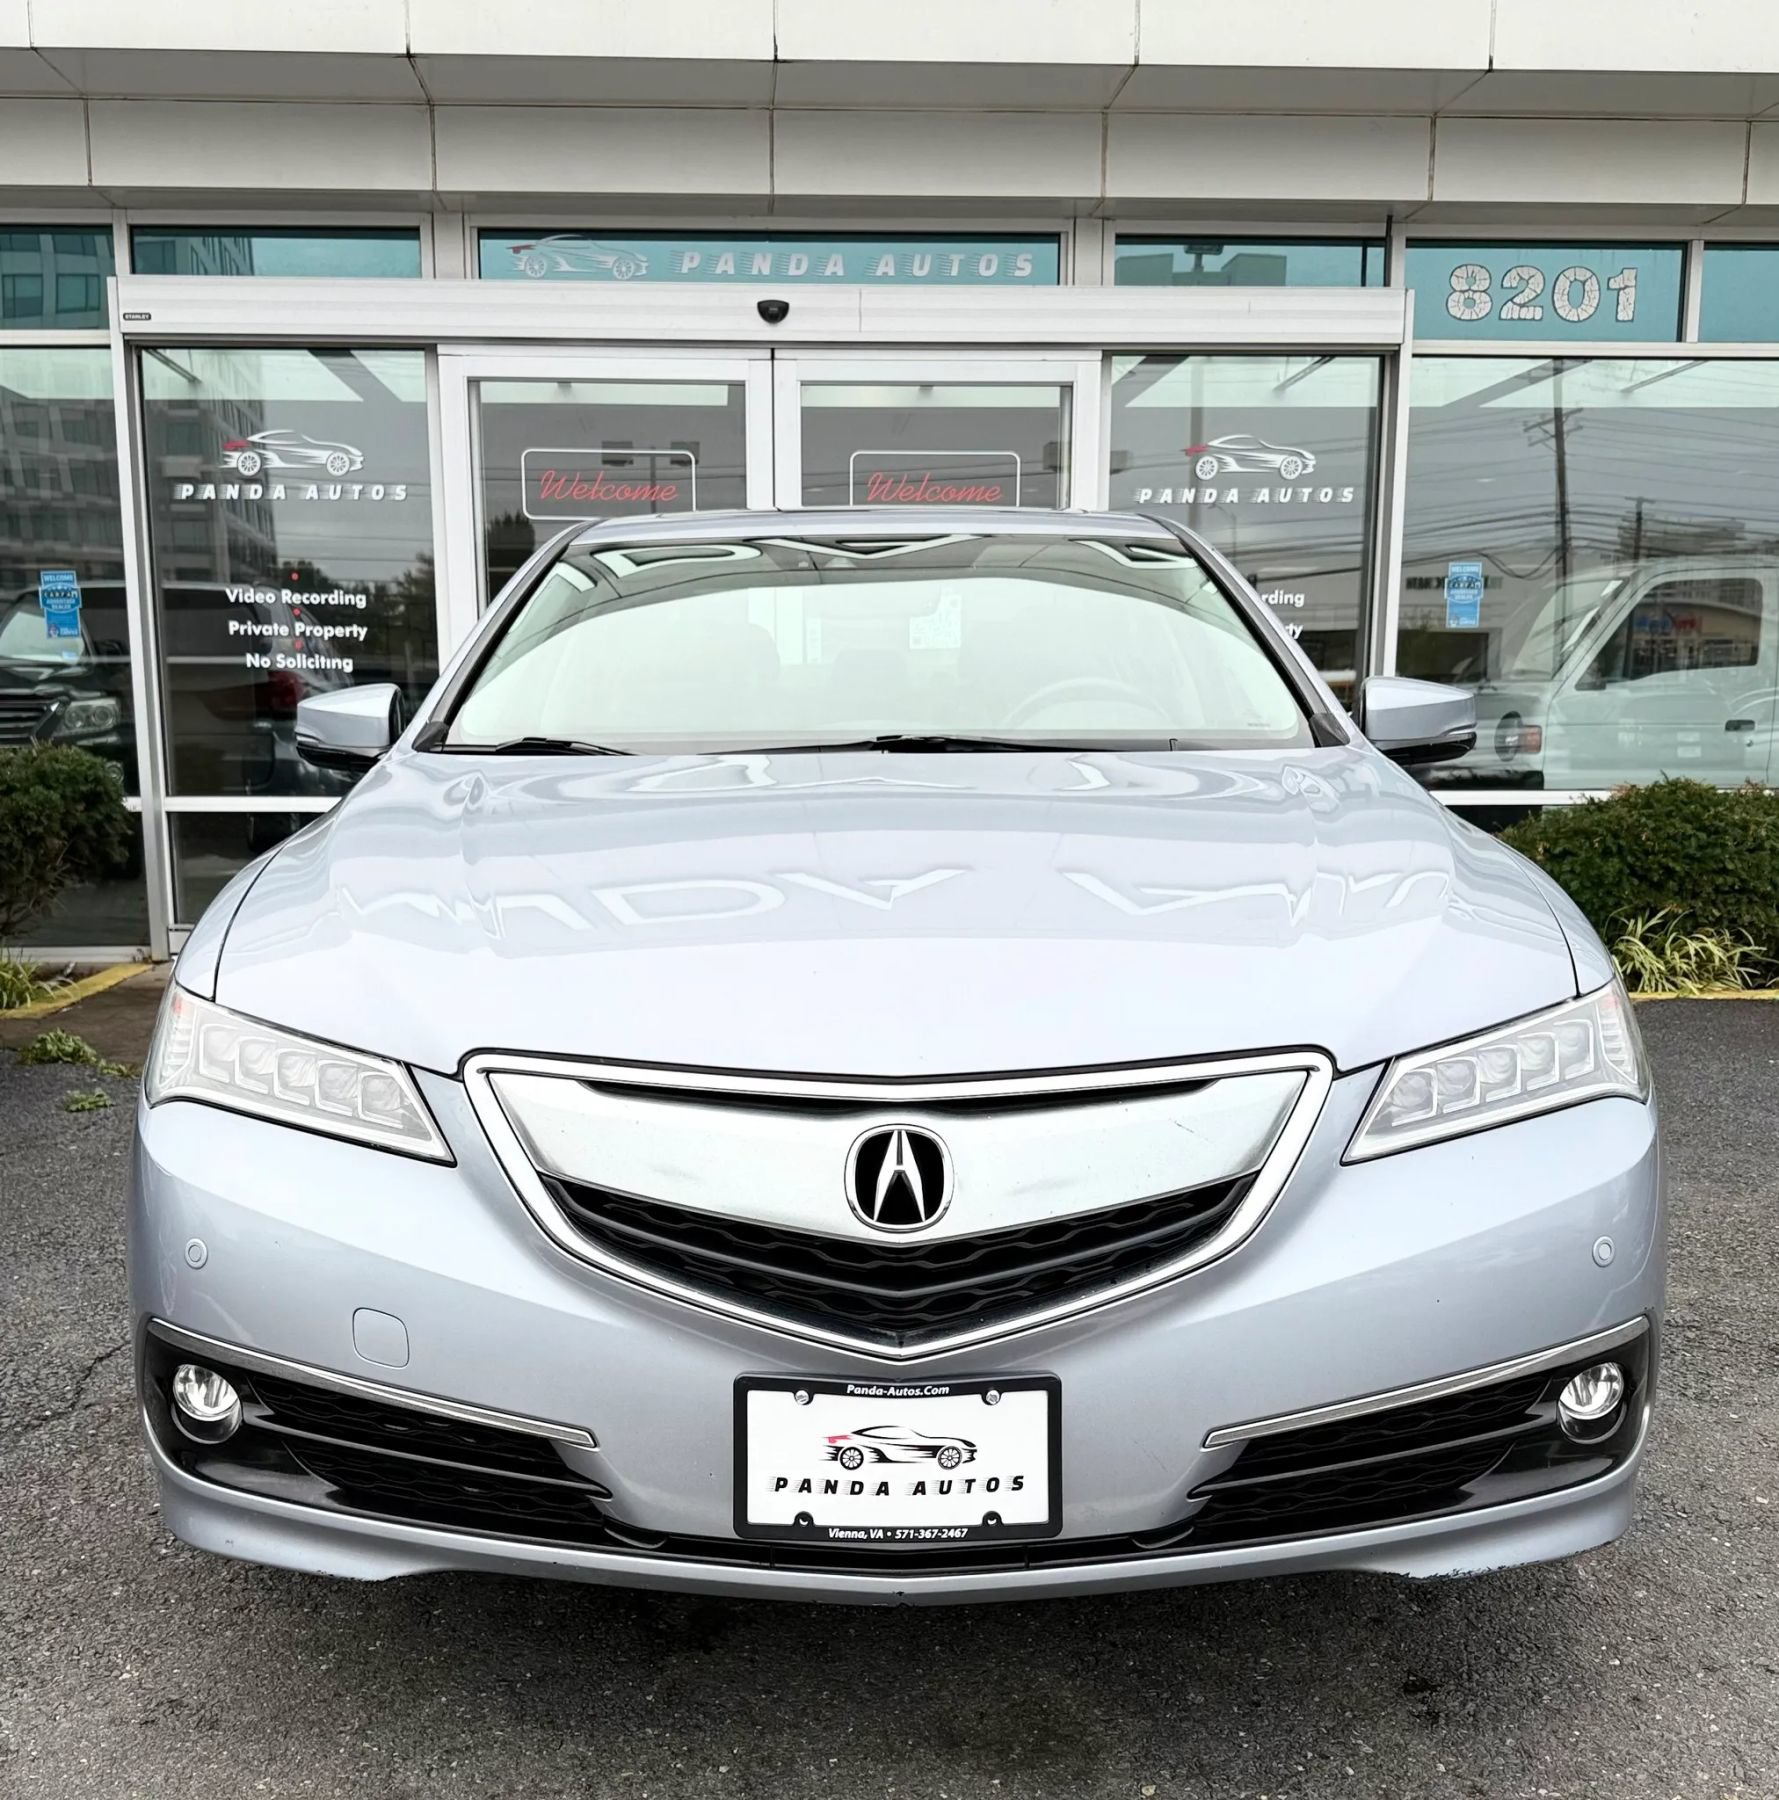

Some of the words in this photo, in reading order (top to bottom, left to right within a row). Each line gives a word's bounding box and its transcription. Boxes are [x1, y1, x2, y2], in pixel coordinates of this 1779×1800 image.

[680, 251, 845, 276] PANDA
[874, 253, 1033, 277] AUTOS
[1446, 263, 1638, 323] 8201
[180, 484, 287, 500] PANDA
[305, 484, 408, 500] AUTOS
[540, 469, 679, 501] Welcome
[867, 471, 1003, 502] Welcome
[1138, 487, 1240, 503] PANDA
[1256, 487, 1355, 503] AUTOS
[225, 588, 277, 604] Video
[281, 588, 367, 609] Recording
[228, 620, 290, 637] Private
[294, 621, 368, 642] Property
[245, 653, 271, 669] No
[276, 653, 354, 673] Soliciting
[846, 1384, 950, 1397] Panda-Autos.Com
[774, 1477, 890, 1496] PANDA
[911, 1475, 1025, 1496] AUTOS
[828, 1528, 868, 1540] Vienna,
[869, 1528, 884, 1539] VA
[894, 1528, 968, 1539] 571-367-2467
